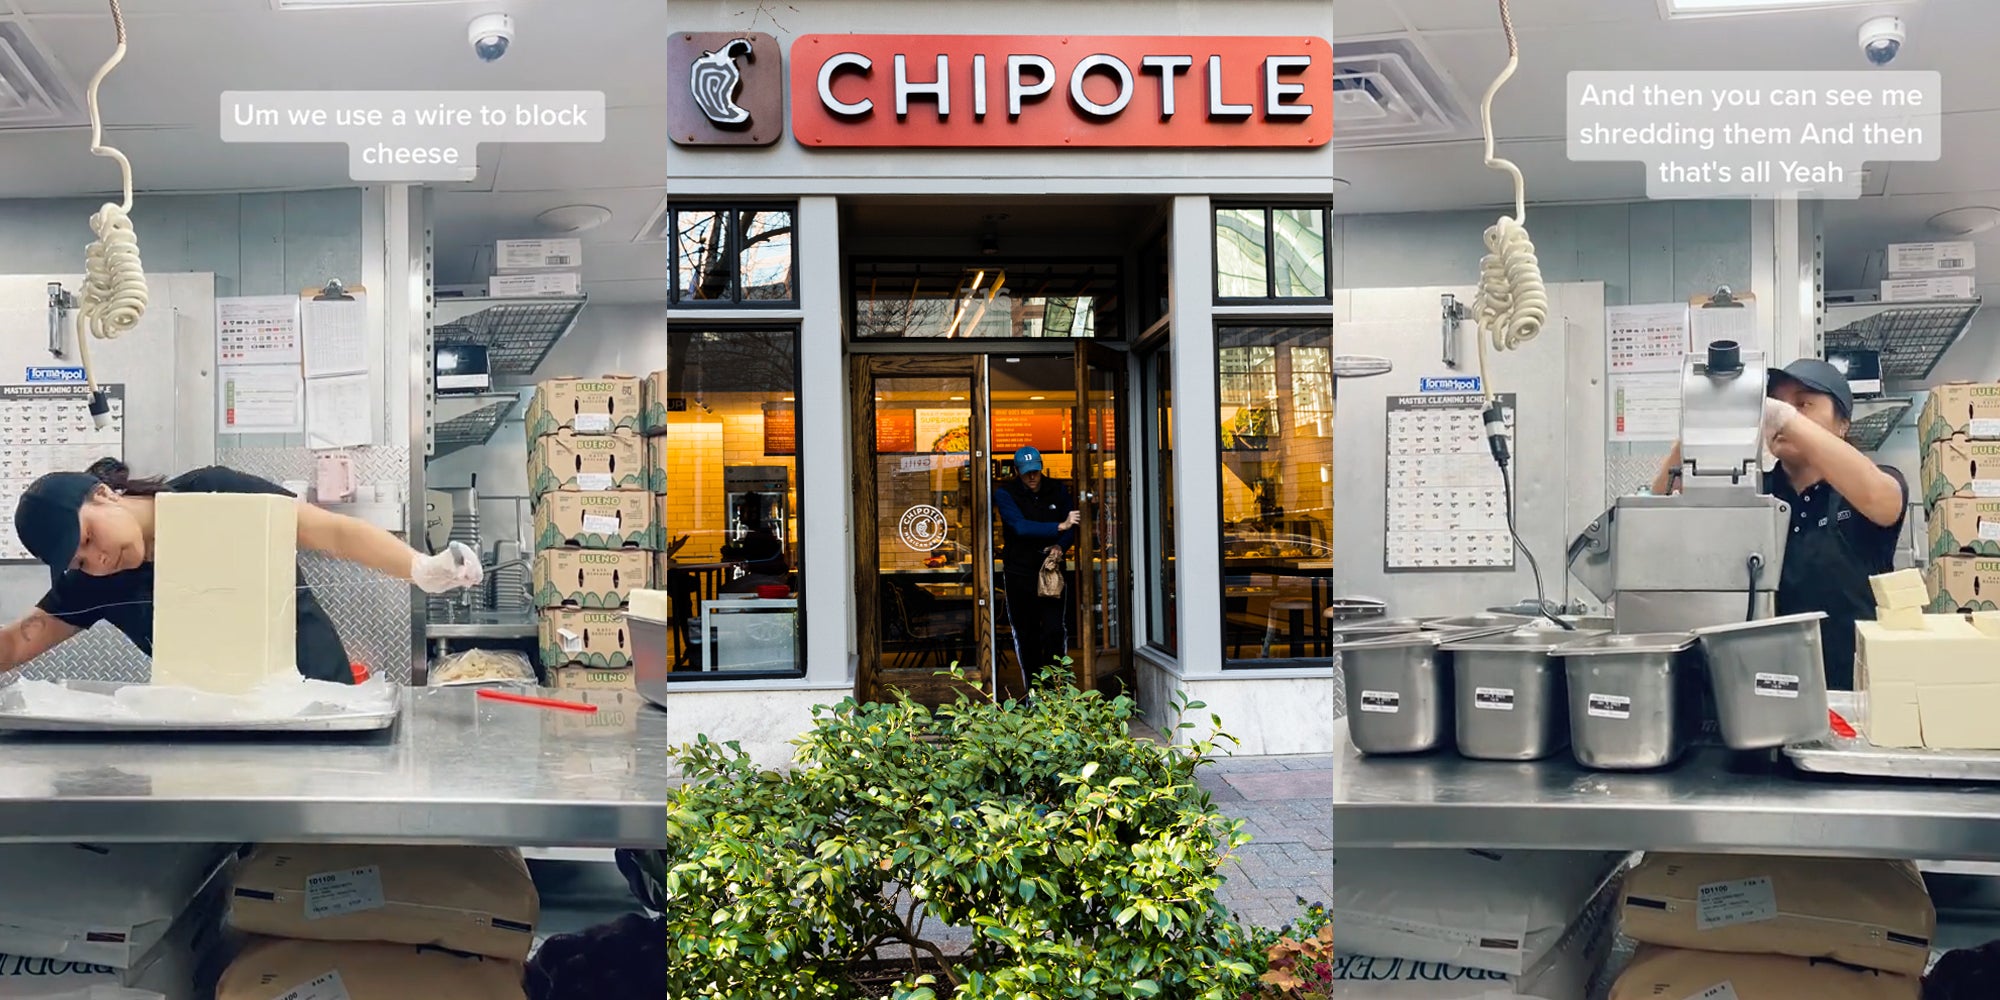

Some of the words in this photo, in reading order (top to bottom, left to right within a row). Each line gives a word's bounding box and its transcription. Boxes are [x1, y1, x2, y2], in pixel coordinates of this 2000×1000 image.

[816, 52, 1314, 122] CHIPOTLE
[4, 386, 33, 394] MASTER
[34, 386, 71, 394] CLEANING
[576, 382, 614, 392] BUENO
[1399, 396, 1427, 405] MASTER
[1428, 395, 1464, 404] CLEANING
[577, 440, 616, 449] BUENO
[581, 496, 620, 505] BUENO
[903, 508, 944, 525] CHIPOTLE
[580, 554, 620, 564] BUENO
[587, 672, 626, 682] BUENO
